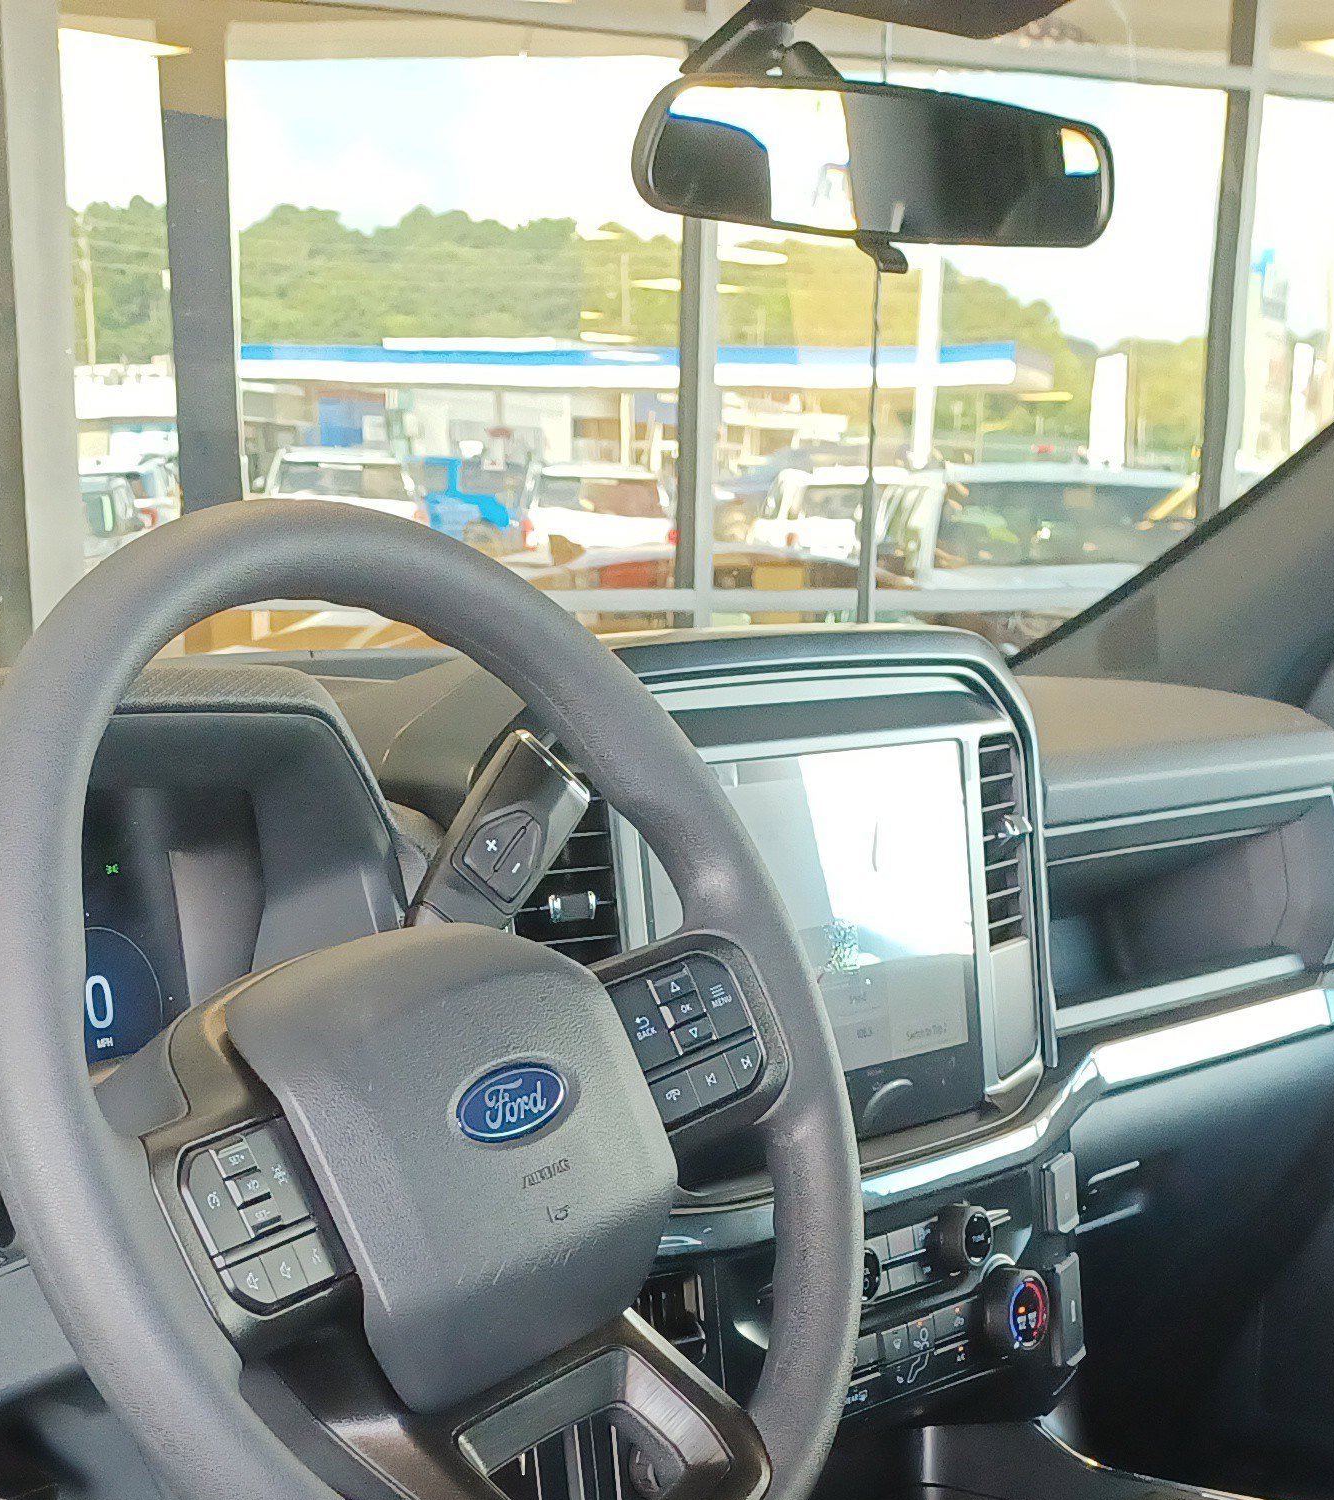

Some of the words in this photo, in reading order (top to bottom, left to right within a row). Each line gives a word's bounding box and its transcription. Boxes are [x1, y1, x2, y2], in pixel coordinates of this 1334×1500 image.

[680, 1003, 693, 1014] OK
[711, 994, 733, 1009] MENU
[636, 1027, 658, 1041] BACK
[484, 1077, 547, 1130] Ford
